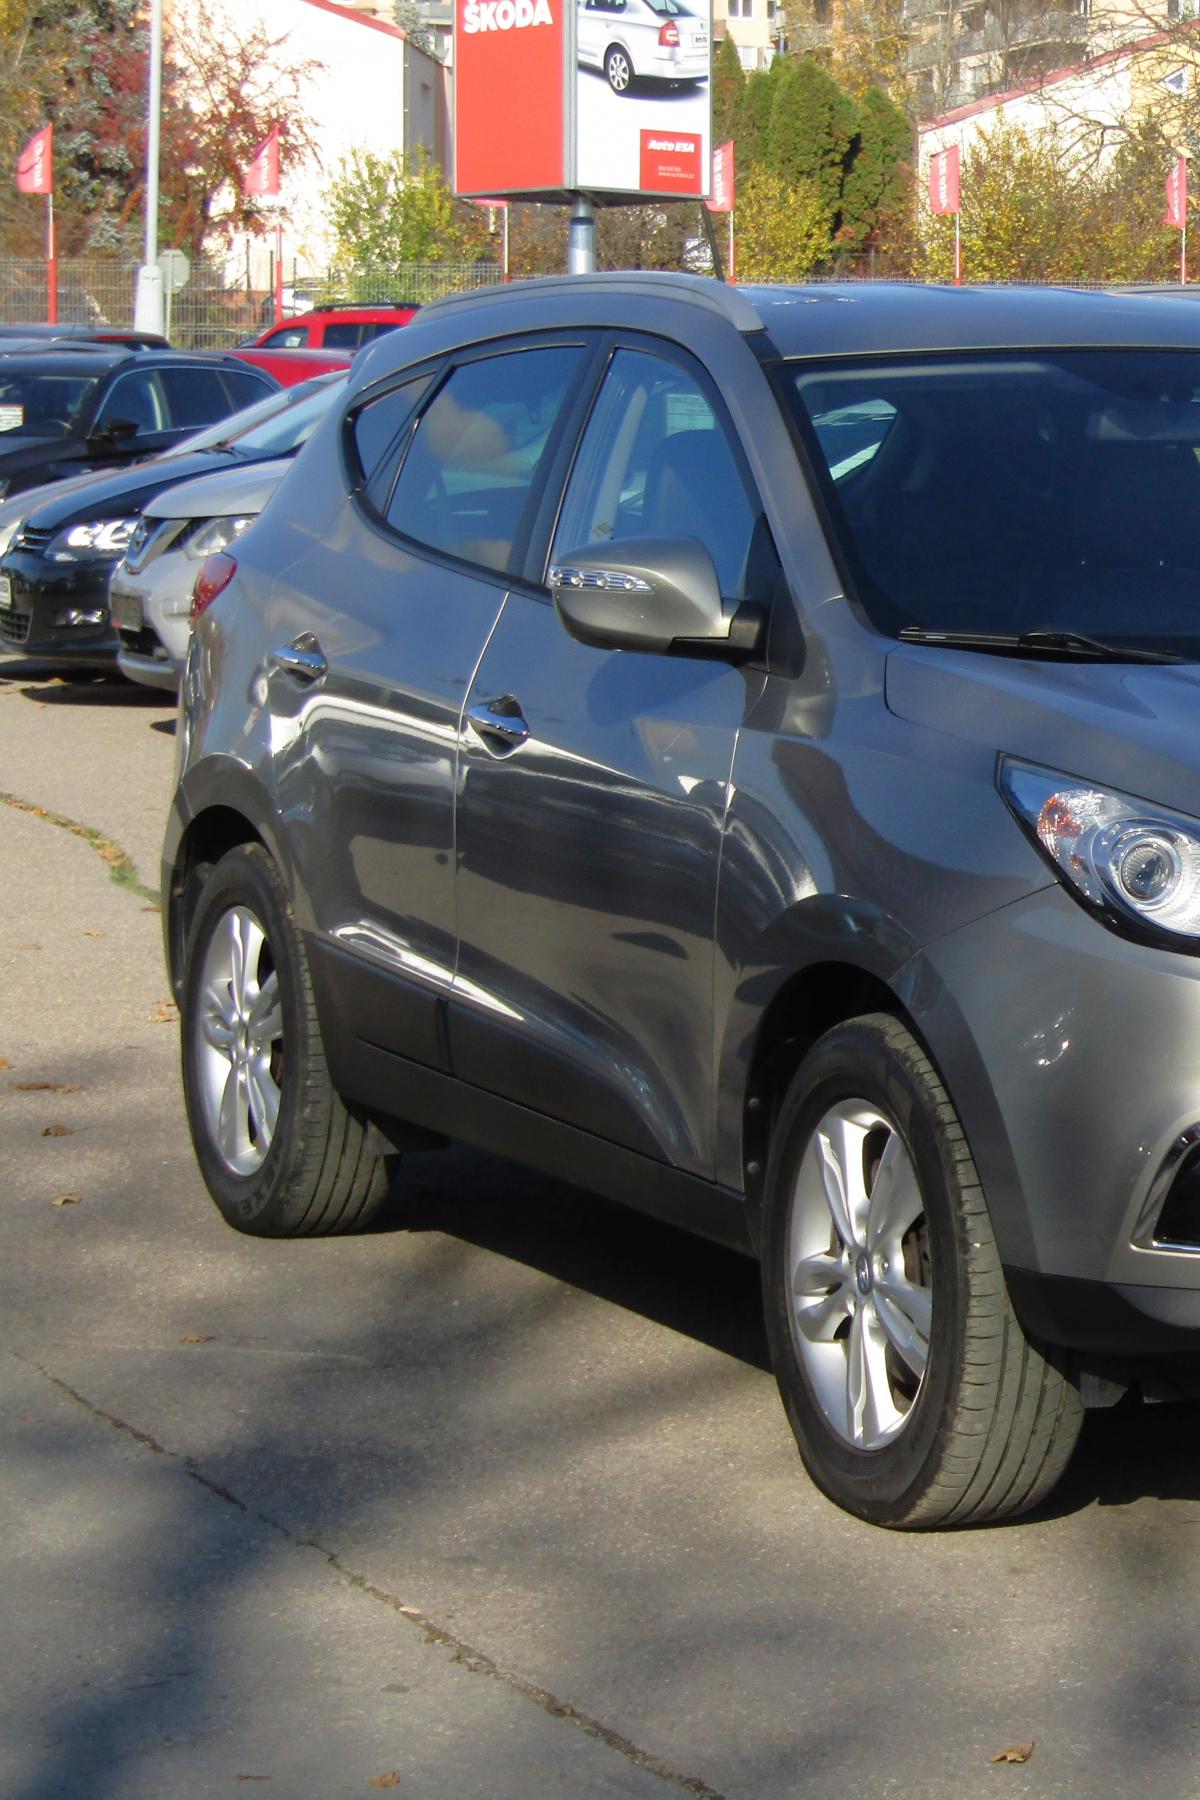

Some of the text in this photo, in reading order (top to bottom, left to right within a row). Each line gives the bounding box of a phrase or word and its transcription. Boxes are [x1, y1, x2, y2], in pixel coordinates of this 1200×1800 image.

[464, 0, 553, 33] ŠKODA
[647, 140, 695, 153] Auto ESA
